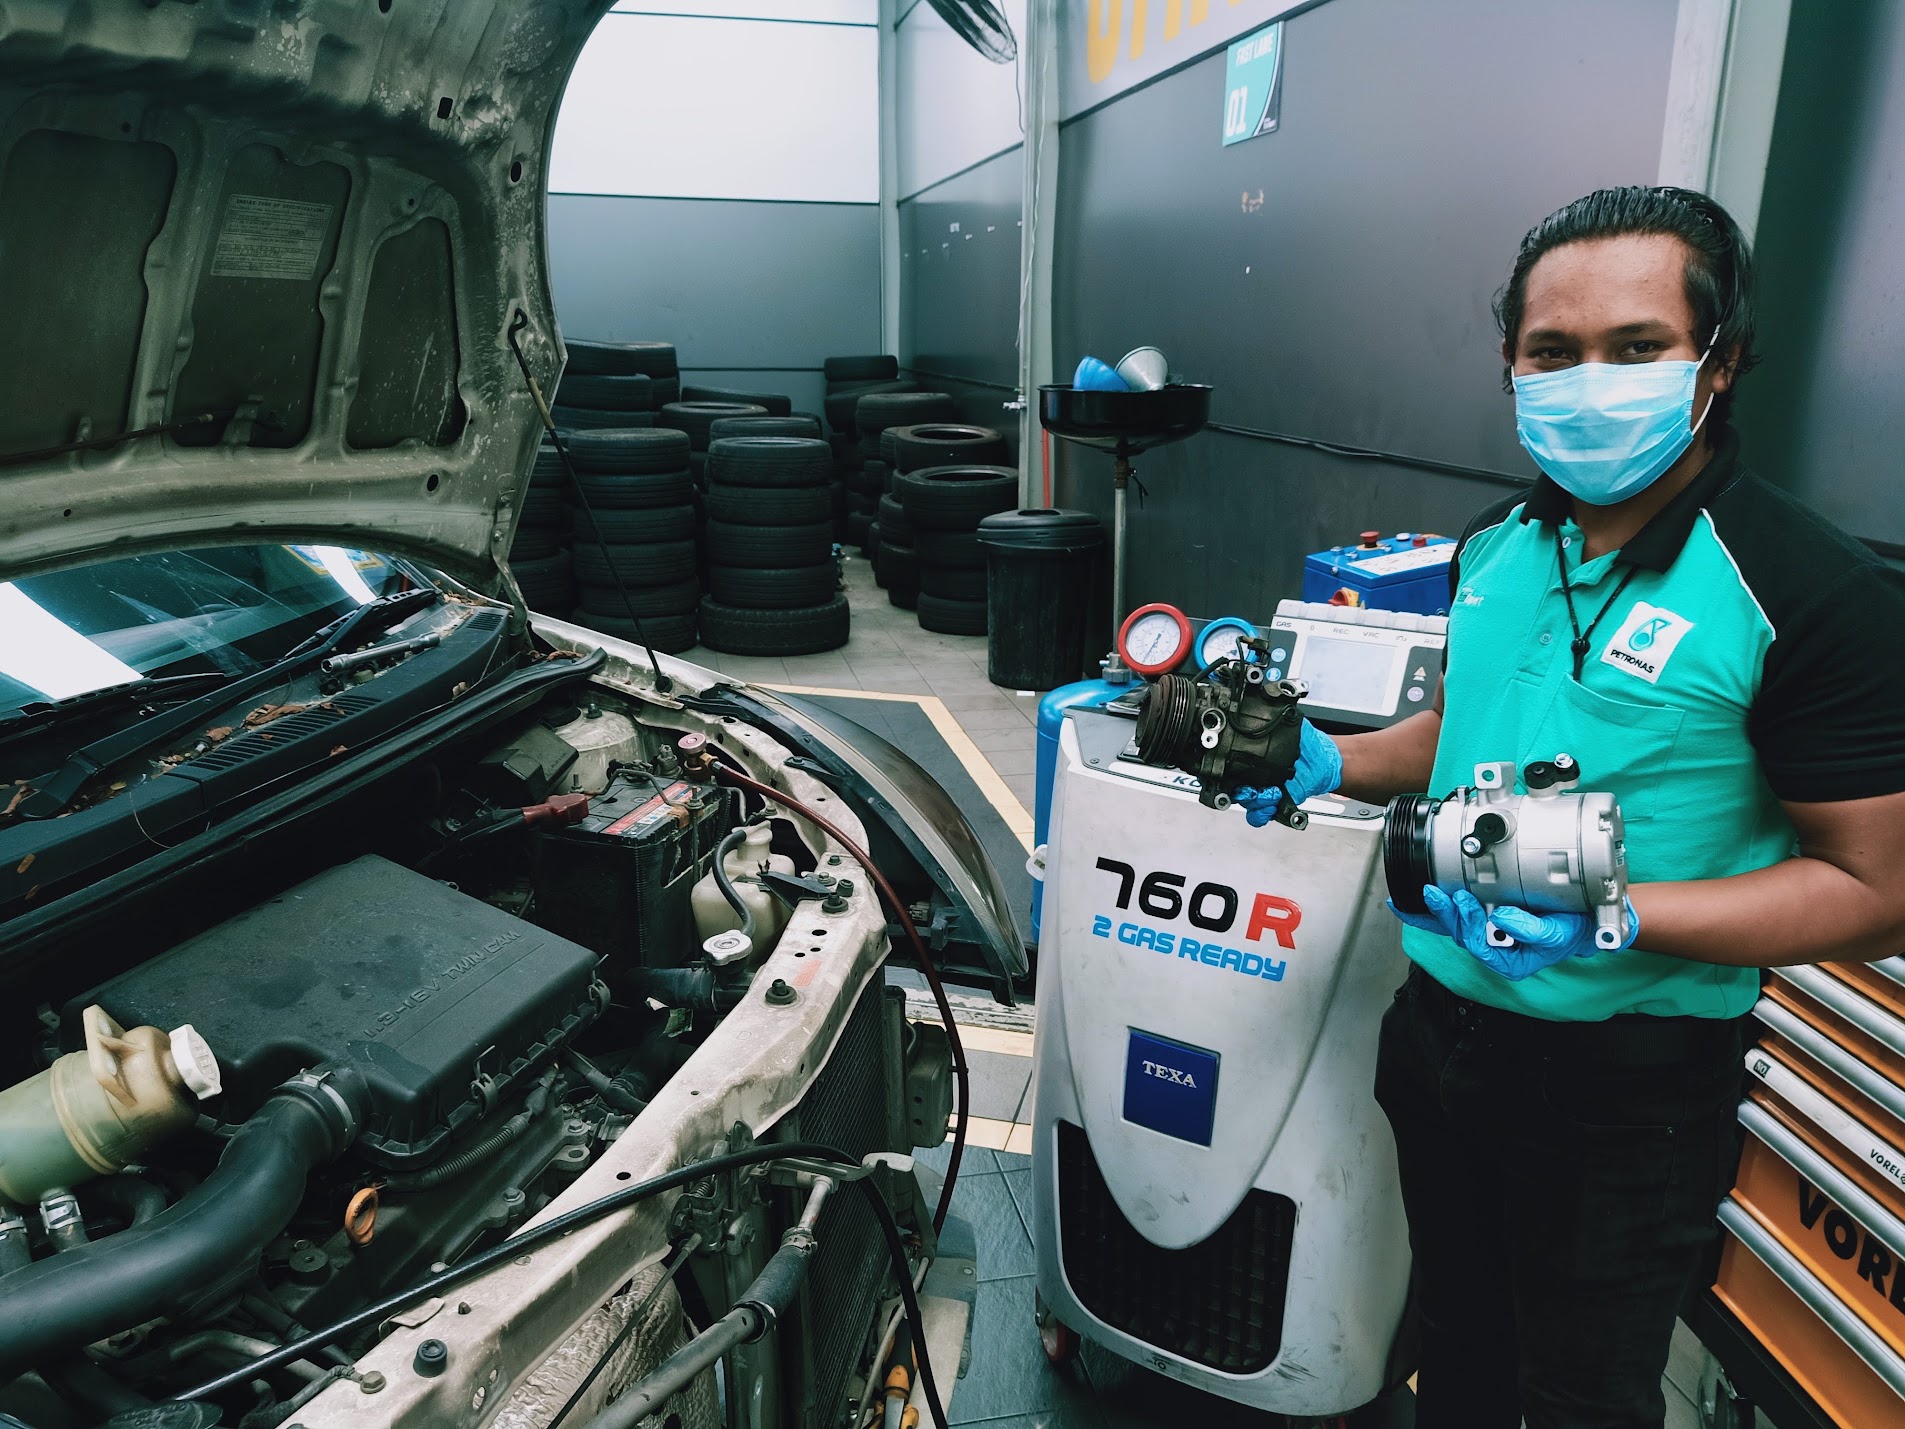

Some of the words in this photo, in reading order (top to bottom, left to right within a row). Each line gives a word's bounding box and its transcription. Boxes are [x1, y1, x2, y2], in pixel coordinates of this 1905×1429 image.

[1226, 86, 1248, 137] 01
[1610, 649, 1655, 674] PETRONAS
[441, 953, 487, 980] TWIN
[483, 930, 522, 954] CAM
[1092, 914, 1112, 939] 2
[1117, 922, 1176, 955] GAS
[1178, 937, 1287, 982] READY
[1142, 1060, 1197, 1089] TEXA
[1870, 1148, 1901, 1179] VOREL
